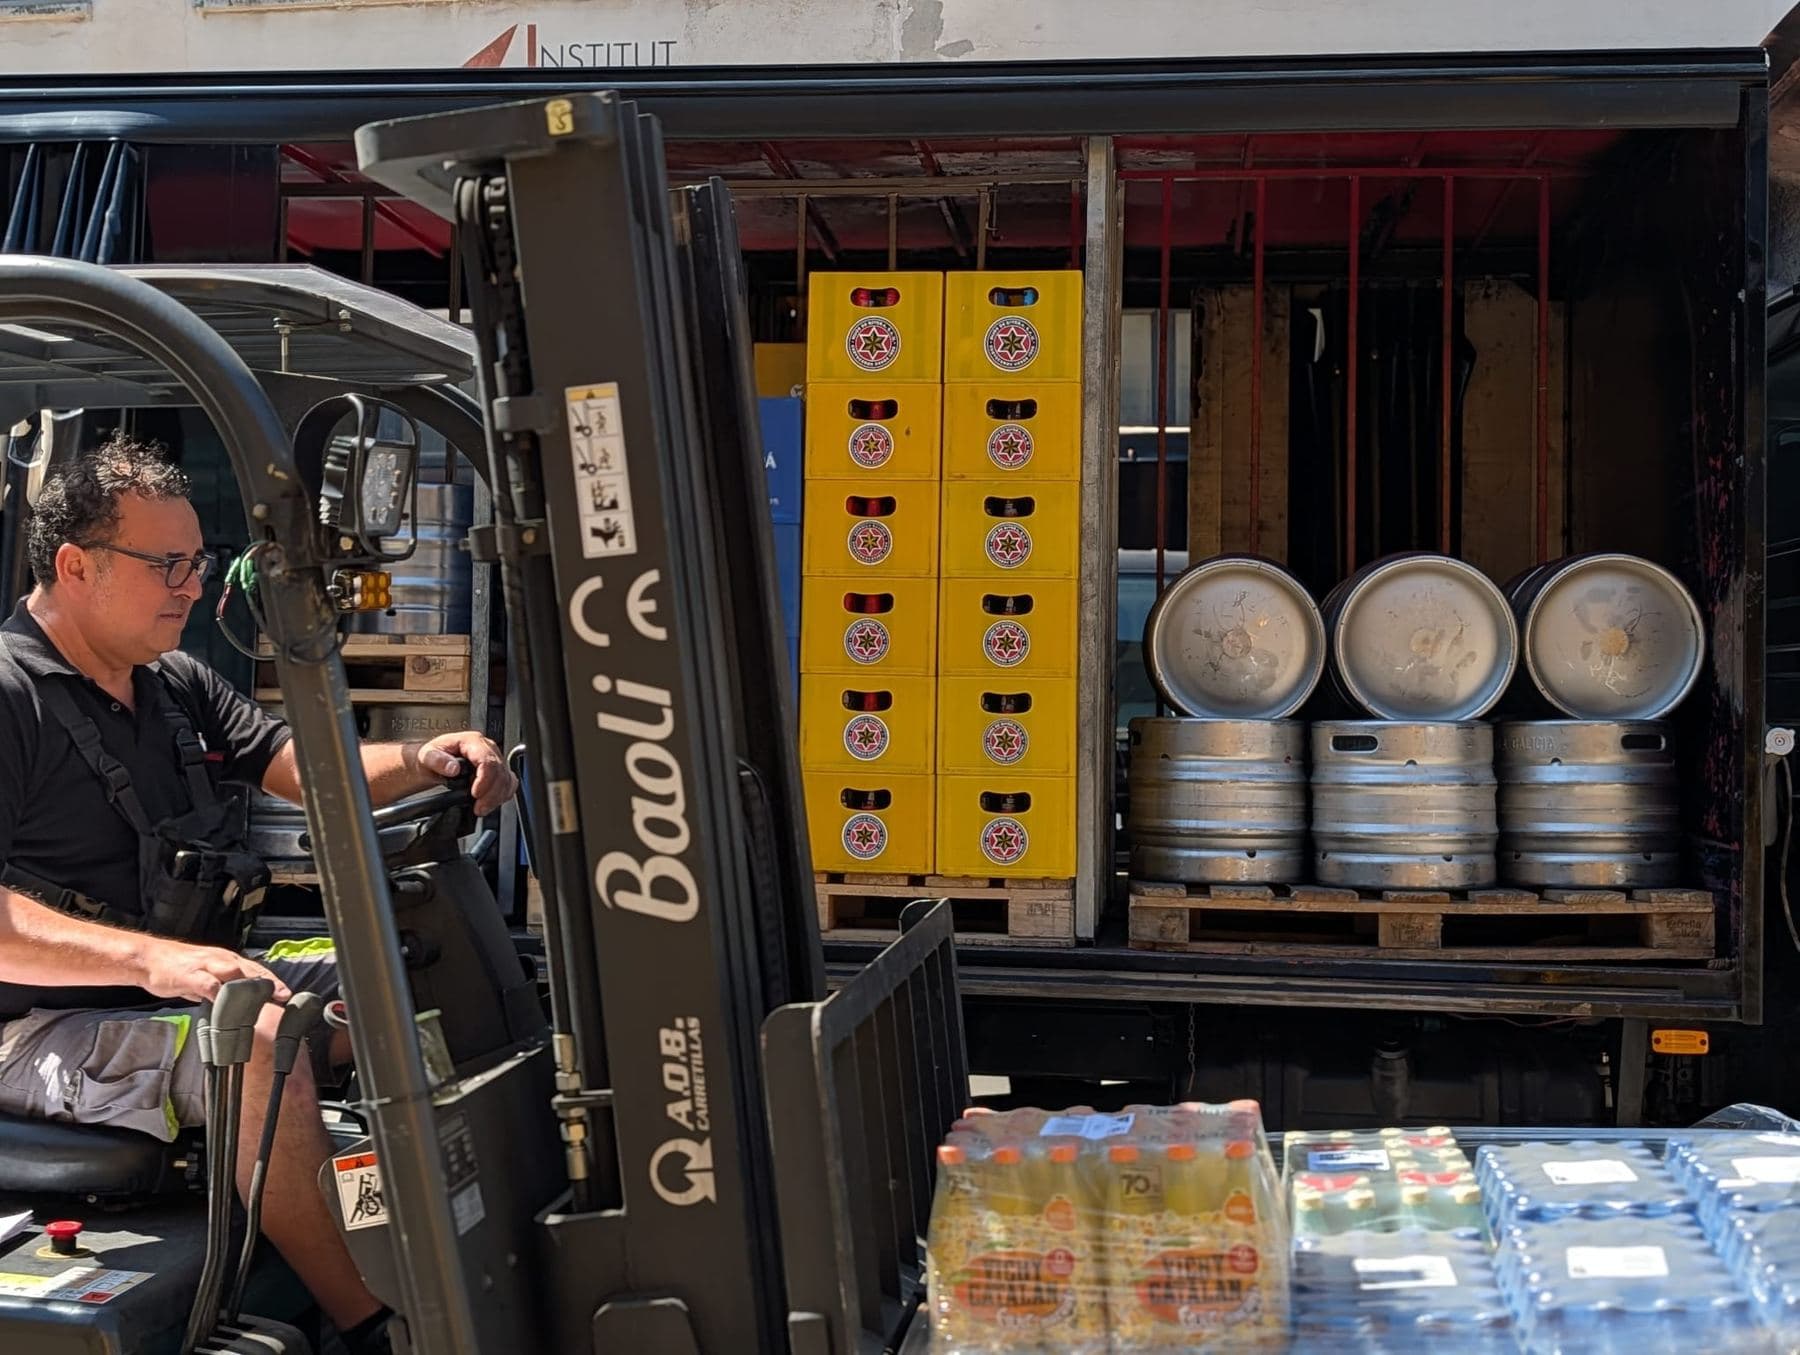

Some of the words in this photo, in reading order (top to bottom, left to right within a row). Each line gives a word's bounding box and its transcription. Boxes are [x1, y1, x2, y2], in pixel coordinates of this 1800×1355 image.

[526, 23, 677, 67] INSTITUT
[591, 673, 700, 923] Baoli
[686, 1016, 710, 1131] CARRETILLAS
